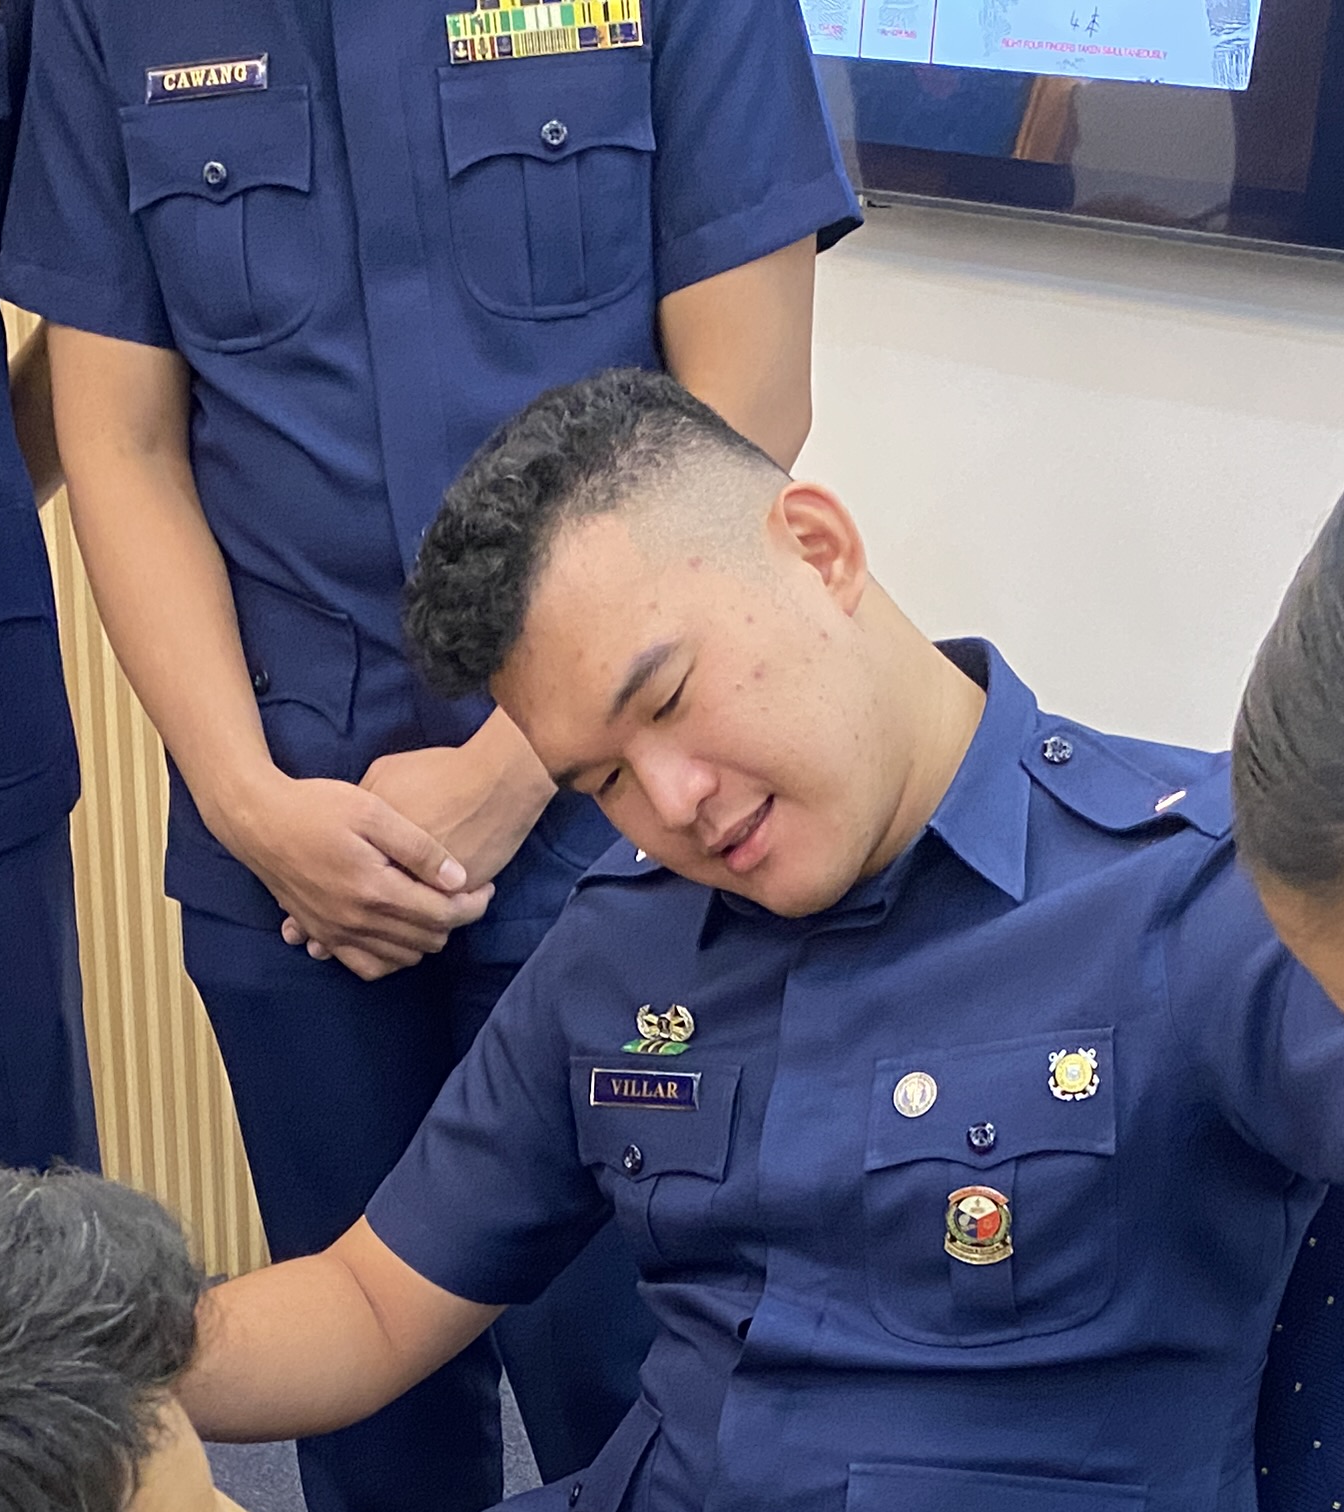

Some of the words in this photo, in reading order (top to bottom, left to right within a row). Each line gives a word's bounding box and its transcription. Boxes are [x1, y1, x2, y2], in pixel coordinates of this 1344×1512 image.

[1023, 39, 1044, 50] FOUR
[1044, 41, 1076, 53] FINGERS
[1077, 44, 1101, 55] TAKEN
[1102, 45, 1168, 60] SIMULTANEOUSLY
[163, 63, 248, 91] CAWANG
[611, 1078, 679, 1099] VILLAR
